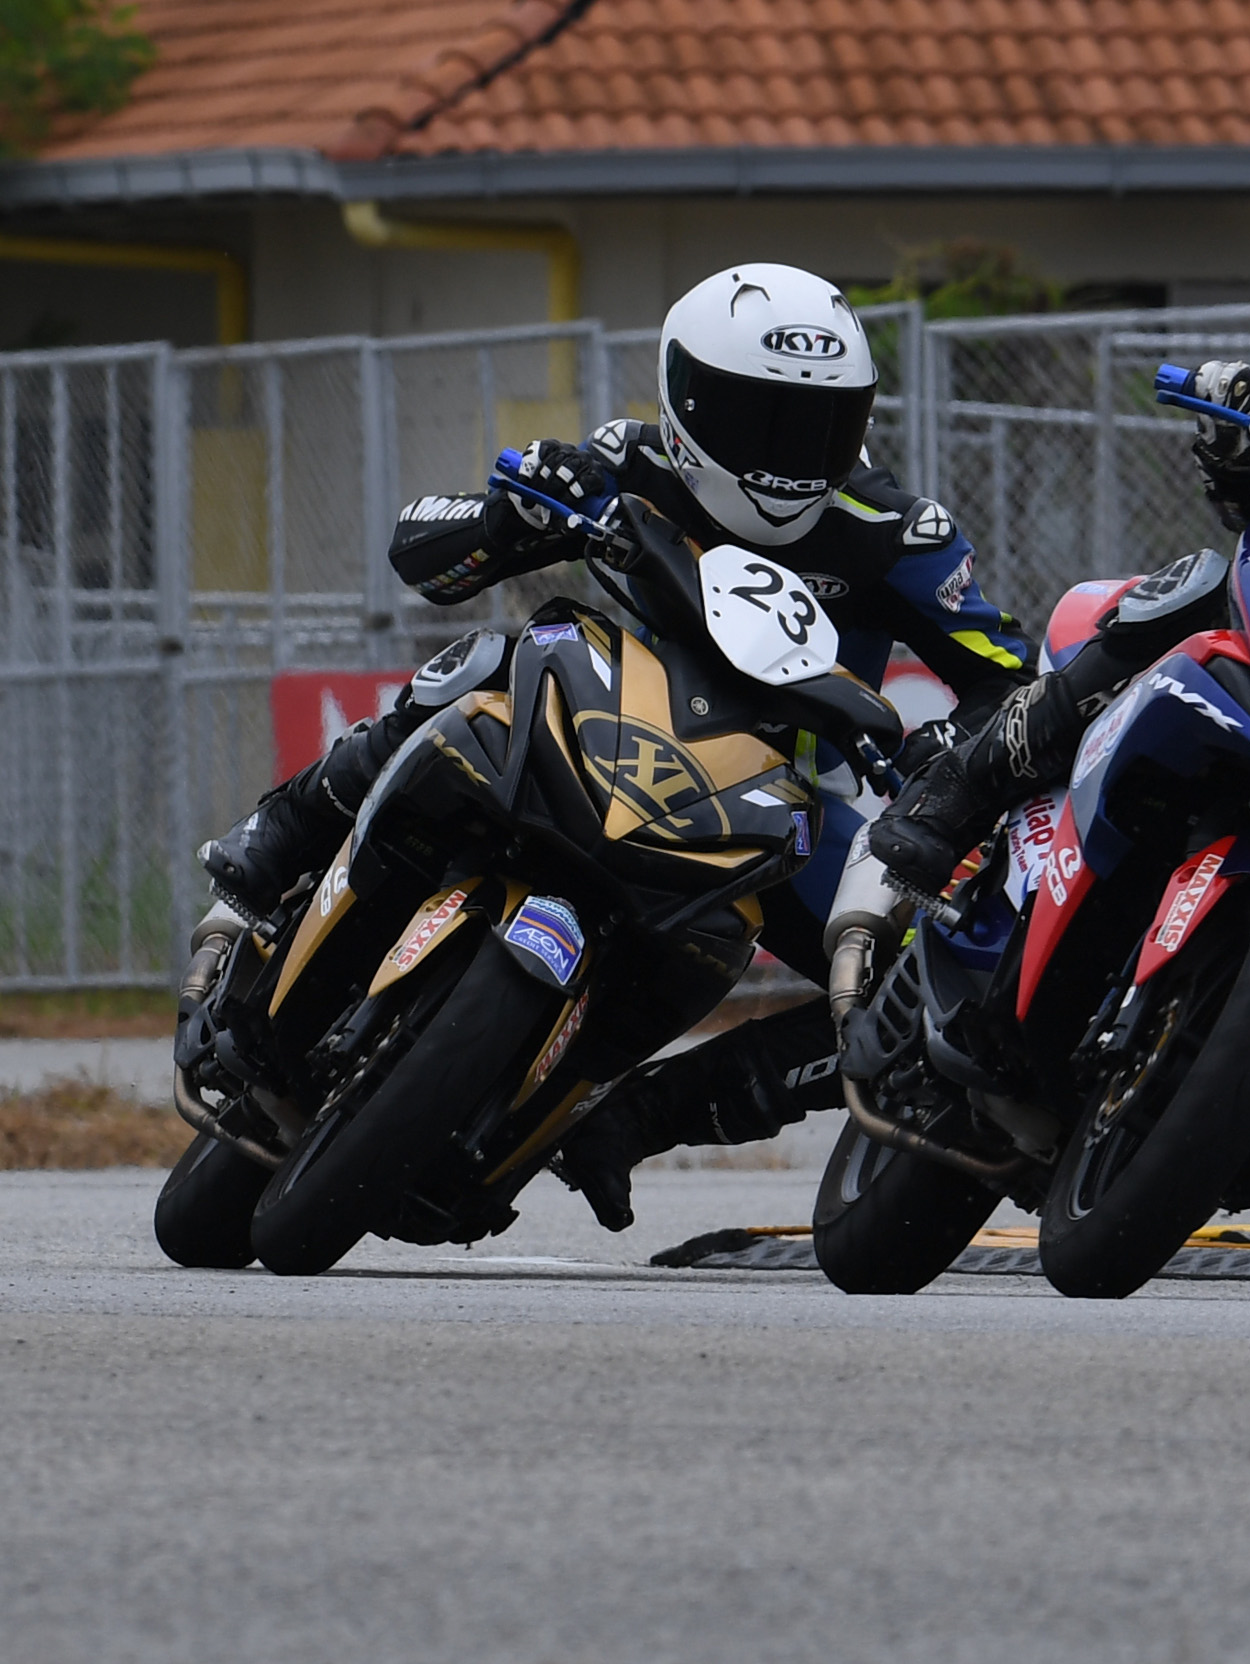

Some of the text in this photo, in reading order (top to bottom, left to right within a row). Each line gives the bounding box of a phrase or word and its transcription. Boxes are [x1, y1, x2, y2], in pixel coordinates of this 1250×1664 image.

[768, 329, 842, 356] KYT
[728, 562, 817, 646] 23
[1149, 673, 1244, 732] NVX
[399, 891, 468, 968] MAXXIS
[1164, 856, 1222, 946] MAXXIS
